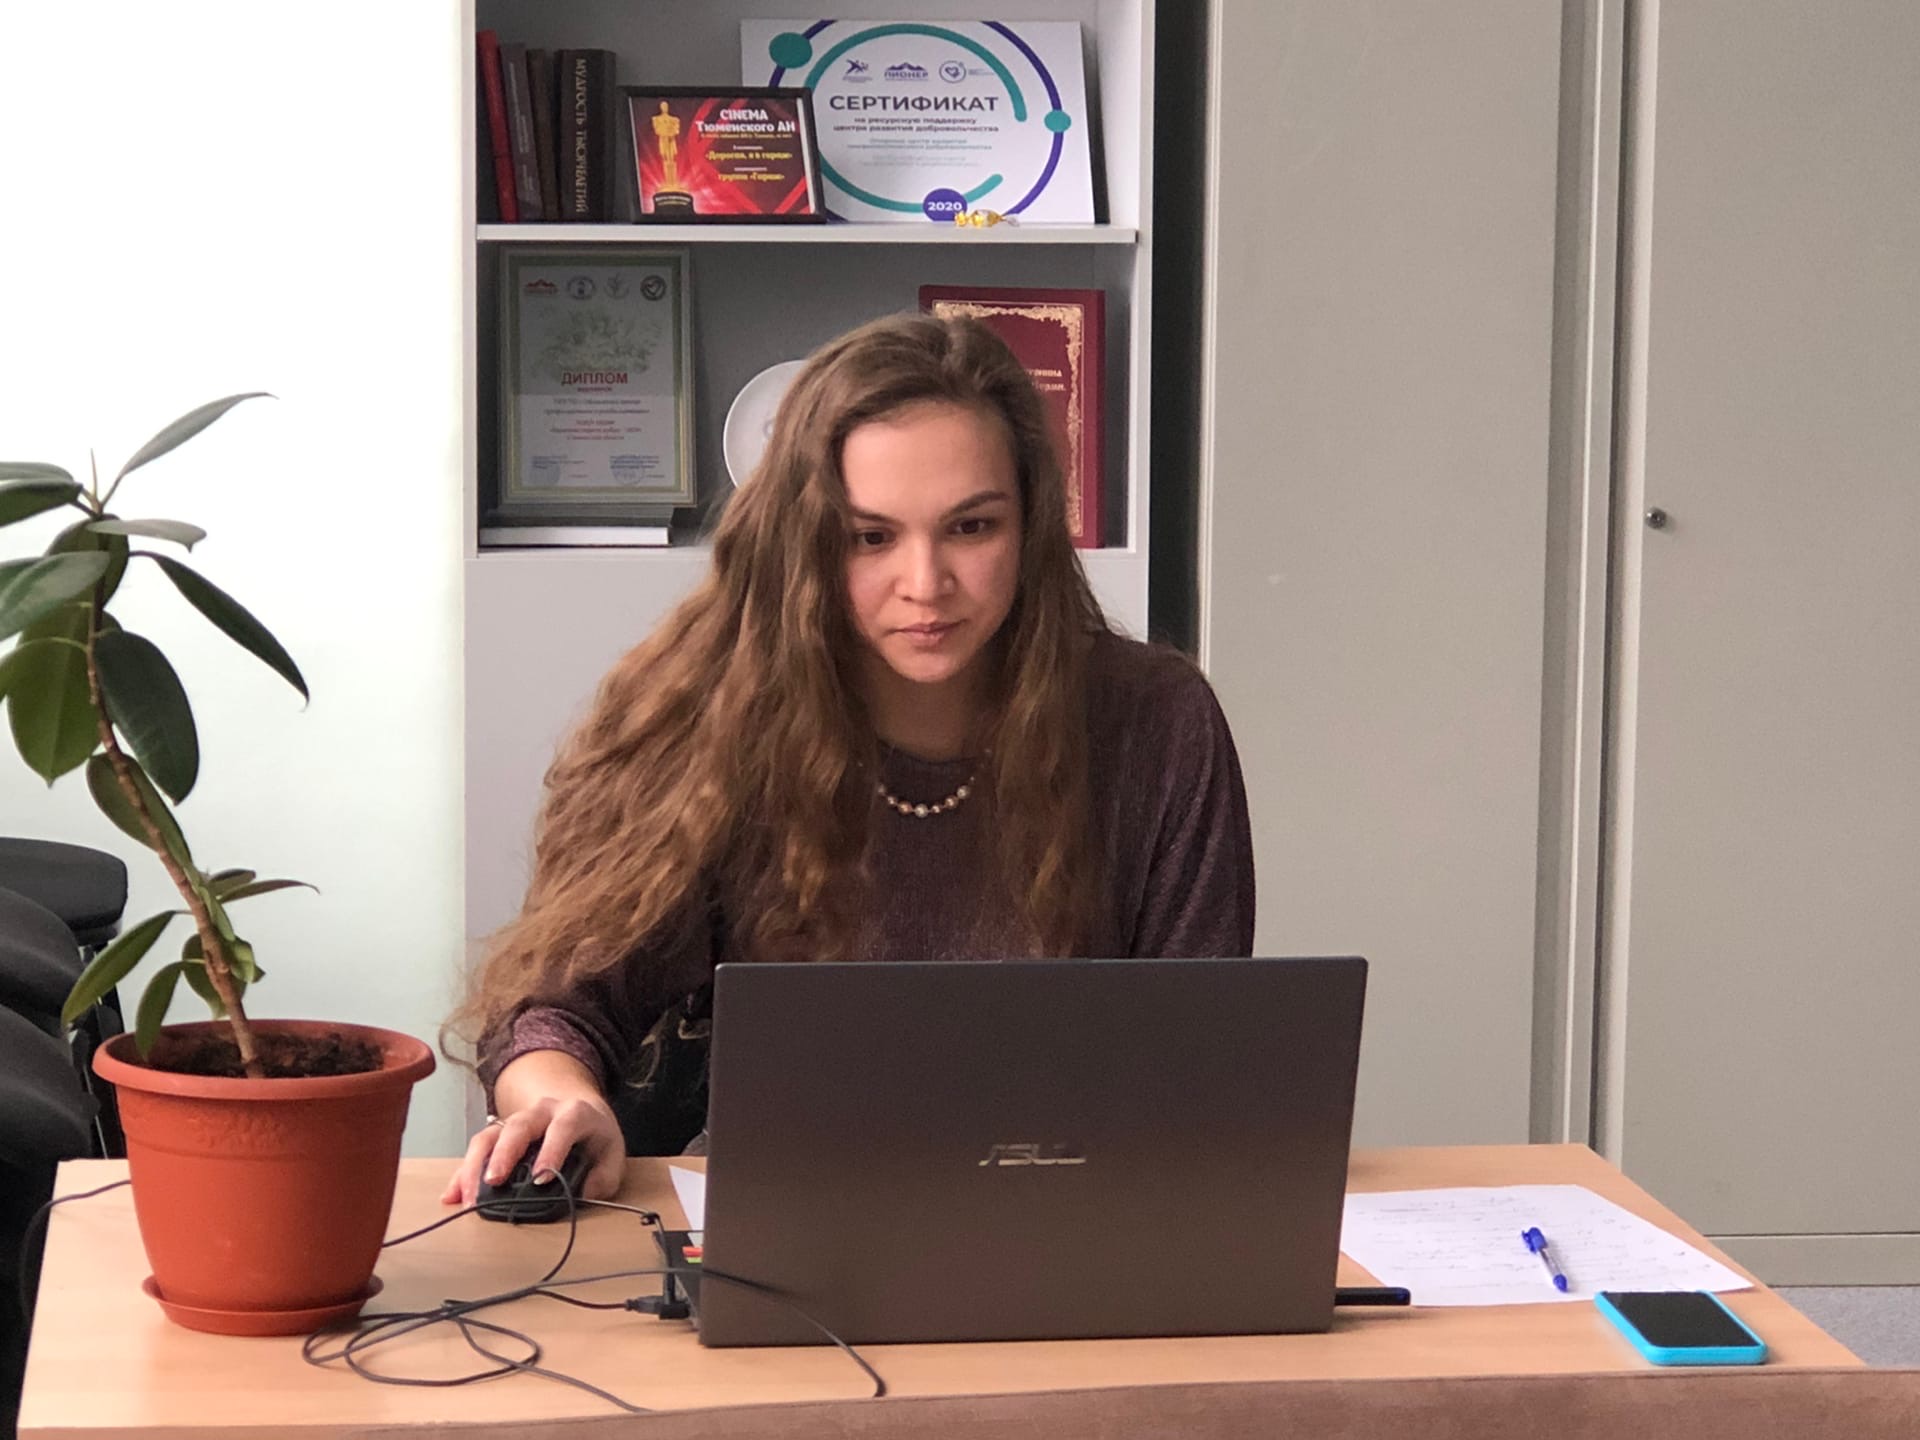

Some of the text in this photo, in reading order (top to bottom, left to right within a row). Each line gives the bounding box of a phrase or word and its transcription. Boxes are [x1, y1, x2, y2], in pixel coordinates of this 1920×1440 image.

[884, 71, 929, 80] ПИОНЕР
[829, 95, 999, 111] СЕРТИФИКАТ
[719, 109, 768, 120] CINEMA
[695, 120, 797, 133] Тюменского АН
[923, 117, 977, 126] поддержку
[869, 125, 914, 133] развития
[915, 125, 999, 133] добровольчества
[575, 58, 589, 213] МУДРОСТЬ ТЫСЯЧЕЛЕТИЙ
[928, 202, 962, 211] 2020
[561, 372, 628, 387] ДИПЛОМ
